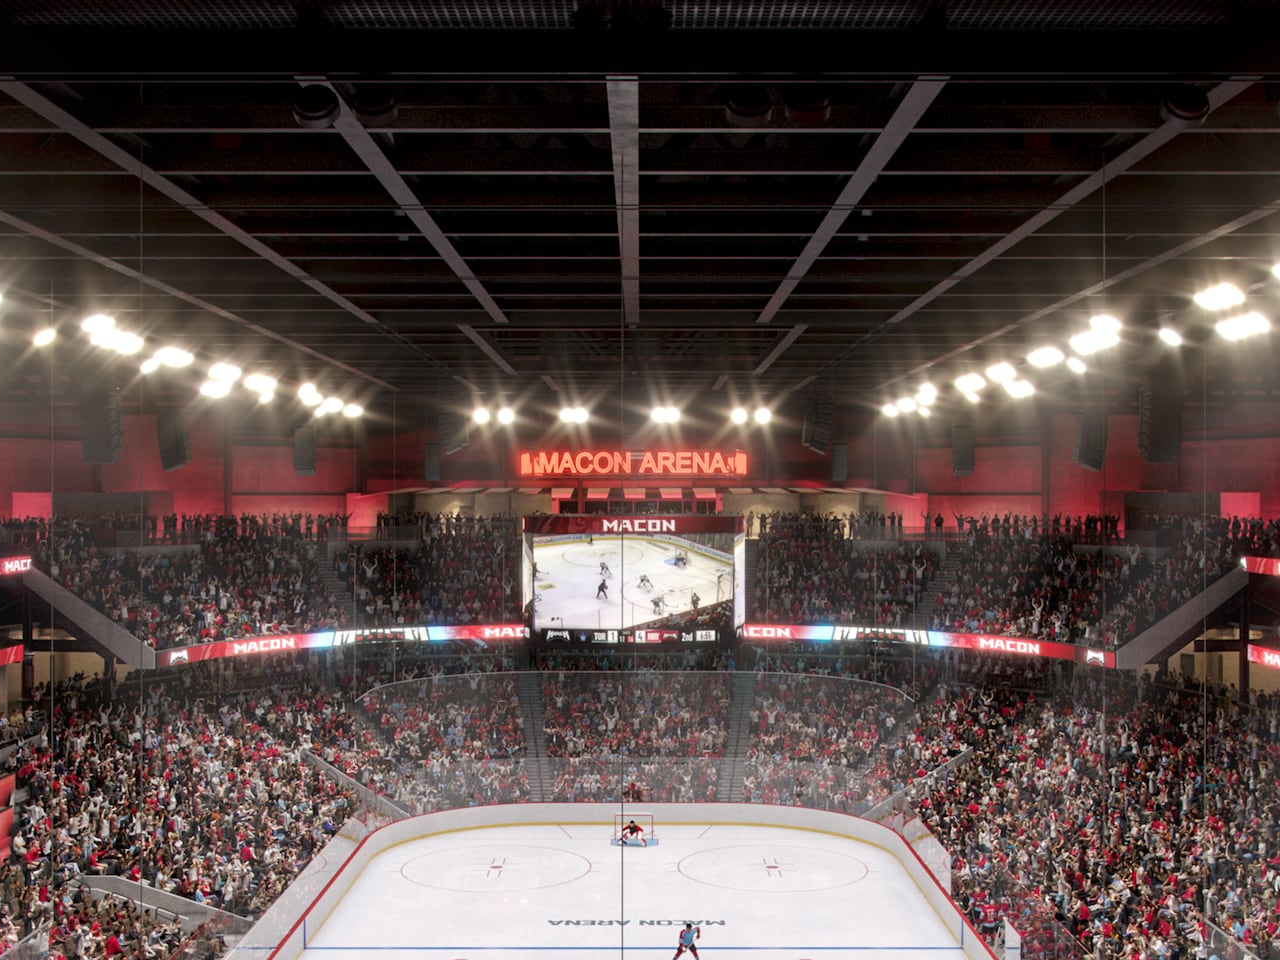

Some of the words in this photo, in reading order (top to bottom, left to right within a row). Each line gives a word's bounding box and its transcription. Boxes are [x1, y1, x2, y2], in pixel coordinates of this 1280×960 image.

[539, 452, 631, 474] MACON
[639, 452, 729, 474] ARENA
[603, 519, 676, 532] MACON
[594, 632, 606, 641] TOR
[681, 631, 694, 642] 2nd
[233, 637, 295, 655] MACON
[979, 637, 1040, 655] MACON
